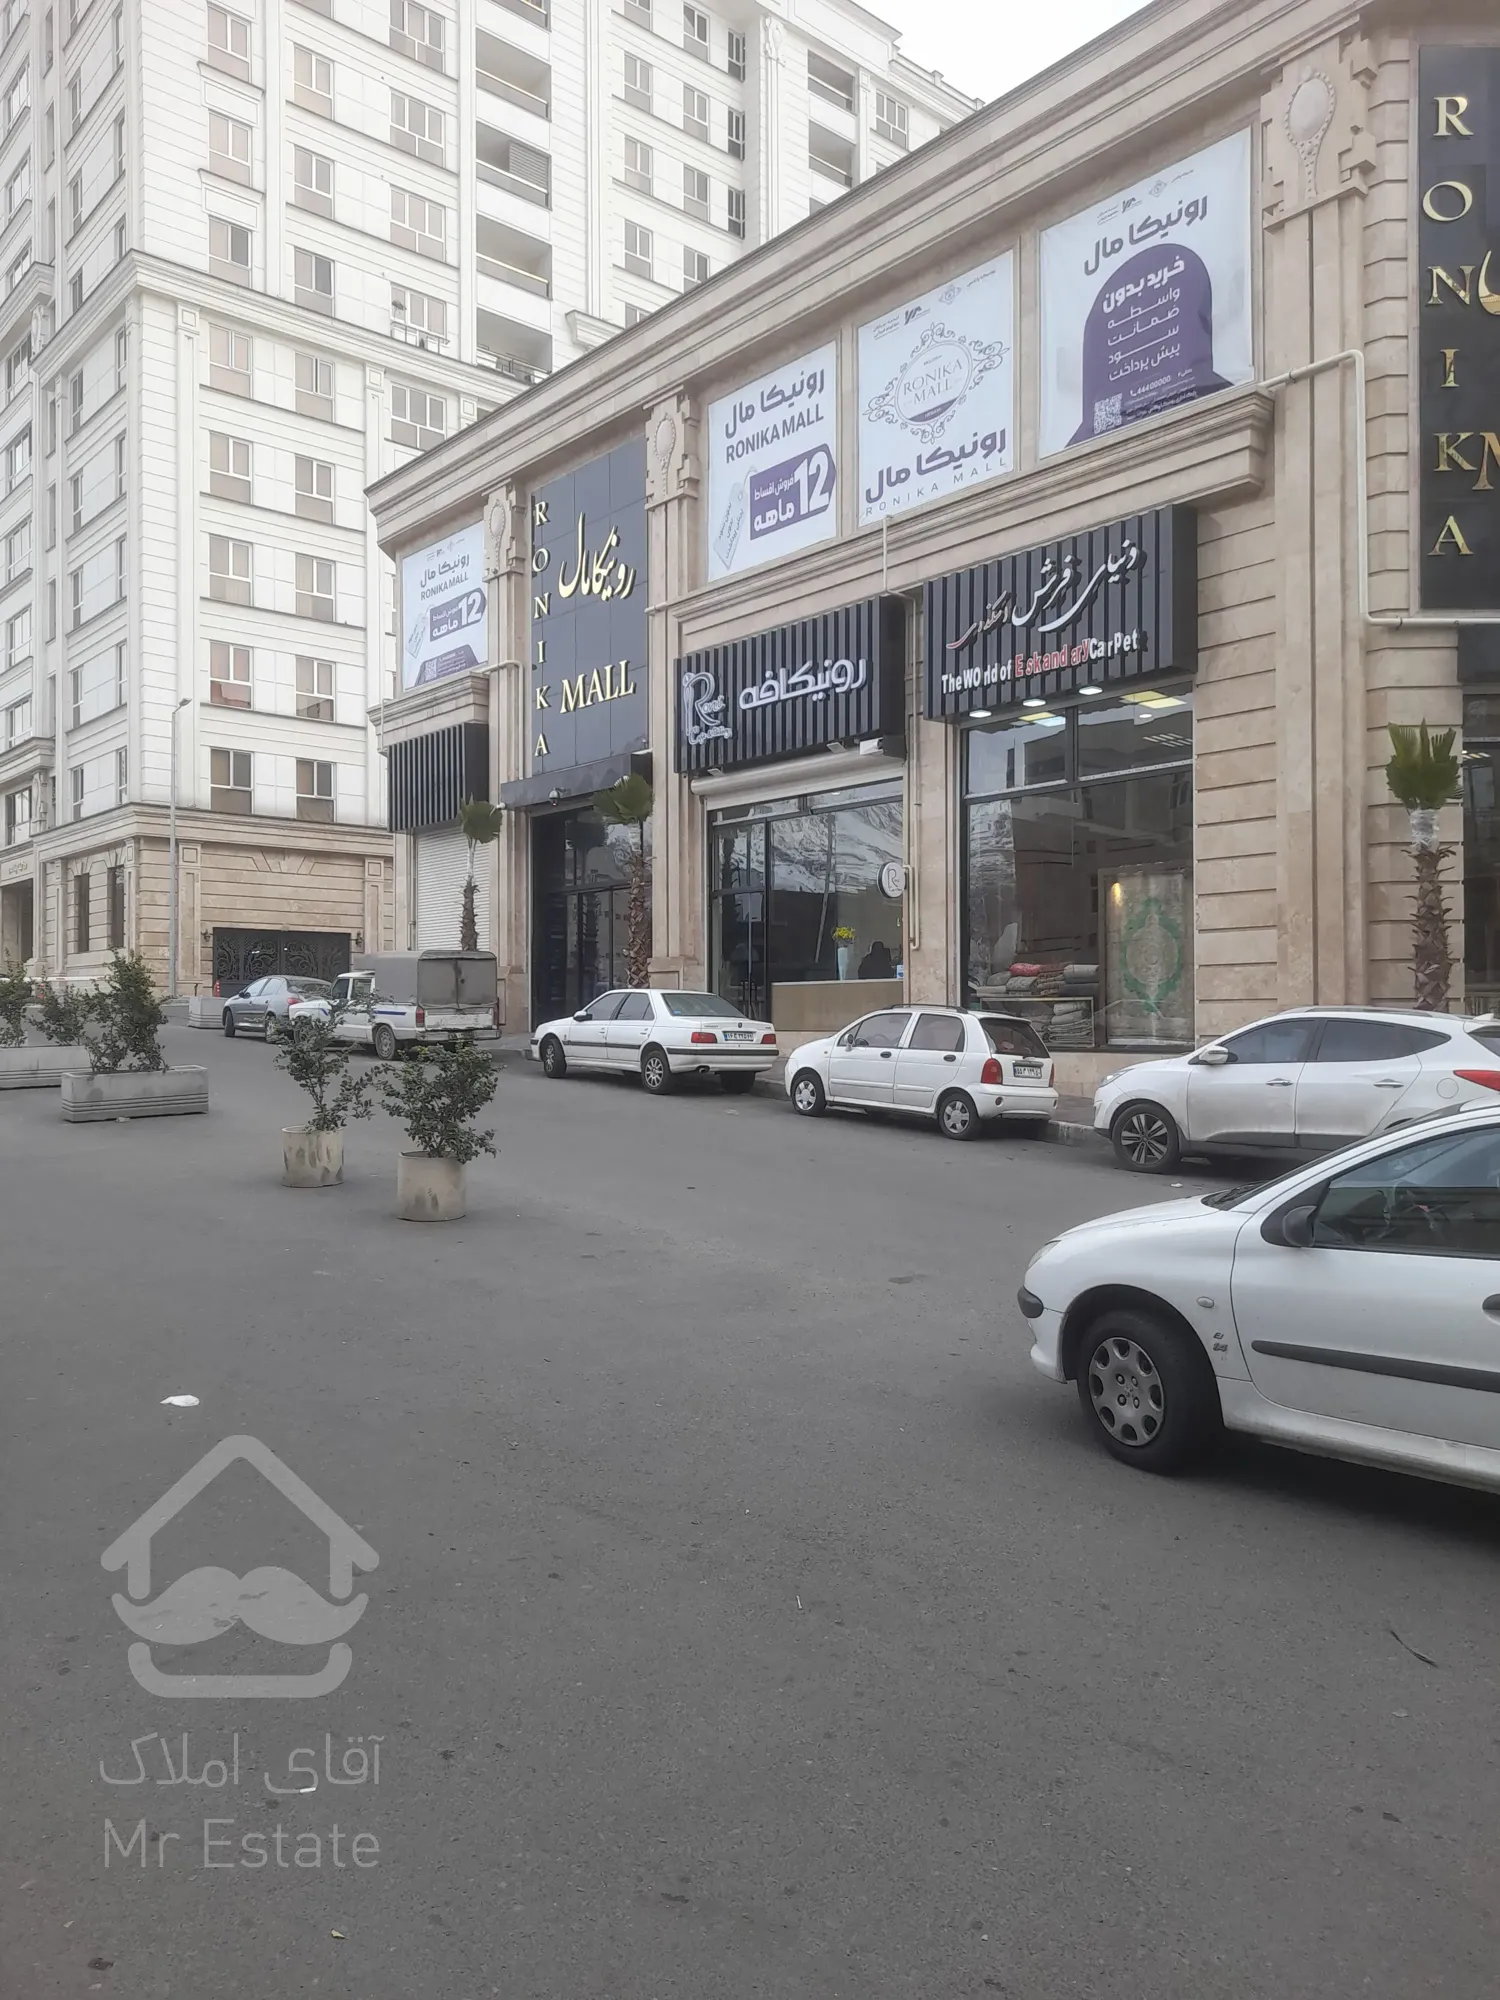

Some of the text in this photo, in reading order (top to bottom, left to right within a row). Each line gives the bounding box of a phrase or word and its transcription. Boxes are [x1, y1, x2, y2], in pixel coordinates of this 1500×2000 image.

[1129, 195, 1207, 246] رونیکا
[1084, 237, 1124, 276] مال
[1103, 255, 1185, 313] خرید بدون
[1422, 95, 1477, 556] RONIKA
[903, 359, 962, 396] RONIKA
[1109, 343, 1180, 381] پیش پرداخت
[725, 368, 825, 440] رونیکا مال
[726, 403, 824, 464] RONIKA MALL
[774, 474, 794, 496] فروش
[794, 451, 830, 516] 12
[865, 427, 1006, 504] رونیکا مال
[865, 456, 1007, 518] RONIKA MALL
[754, 498, 795, 532] ماهه
[420, 567, 437, 588] مال
[421, 572, 469, 601] RONIKA MALL
[438, 553, 470, 576] رونیکا
[1011, 554, 1073, 626] فرش
[1037, 538, 1138, 632] دنیای
[432, 617, 459, 637] ماهه
[458, 591, 482, 626] 12
[531, 500, 551, 758] RONIKA
[560, 659, 635, 714] MALL
[941, 672, 963, 694] The
[1000, 659, 1012, 680] of
